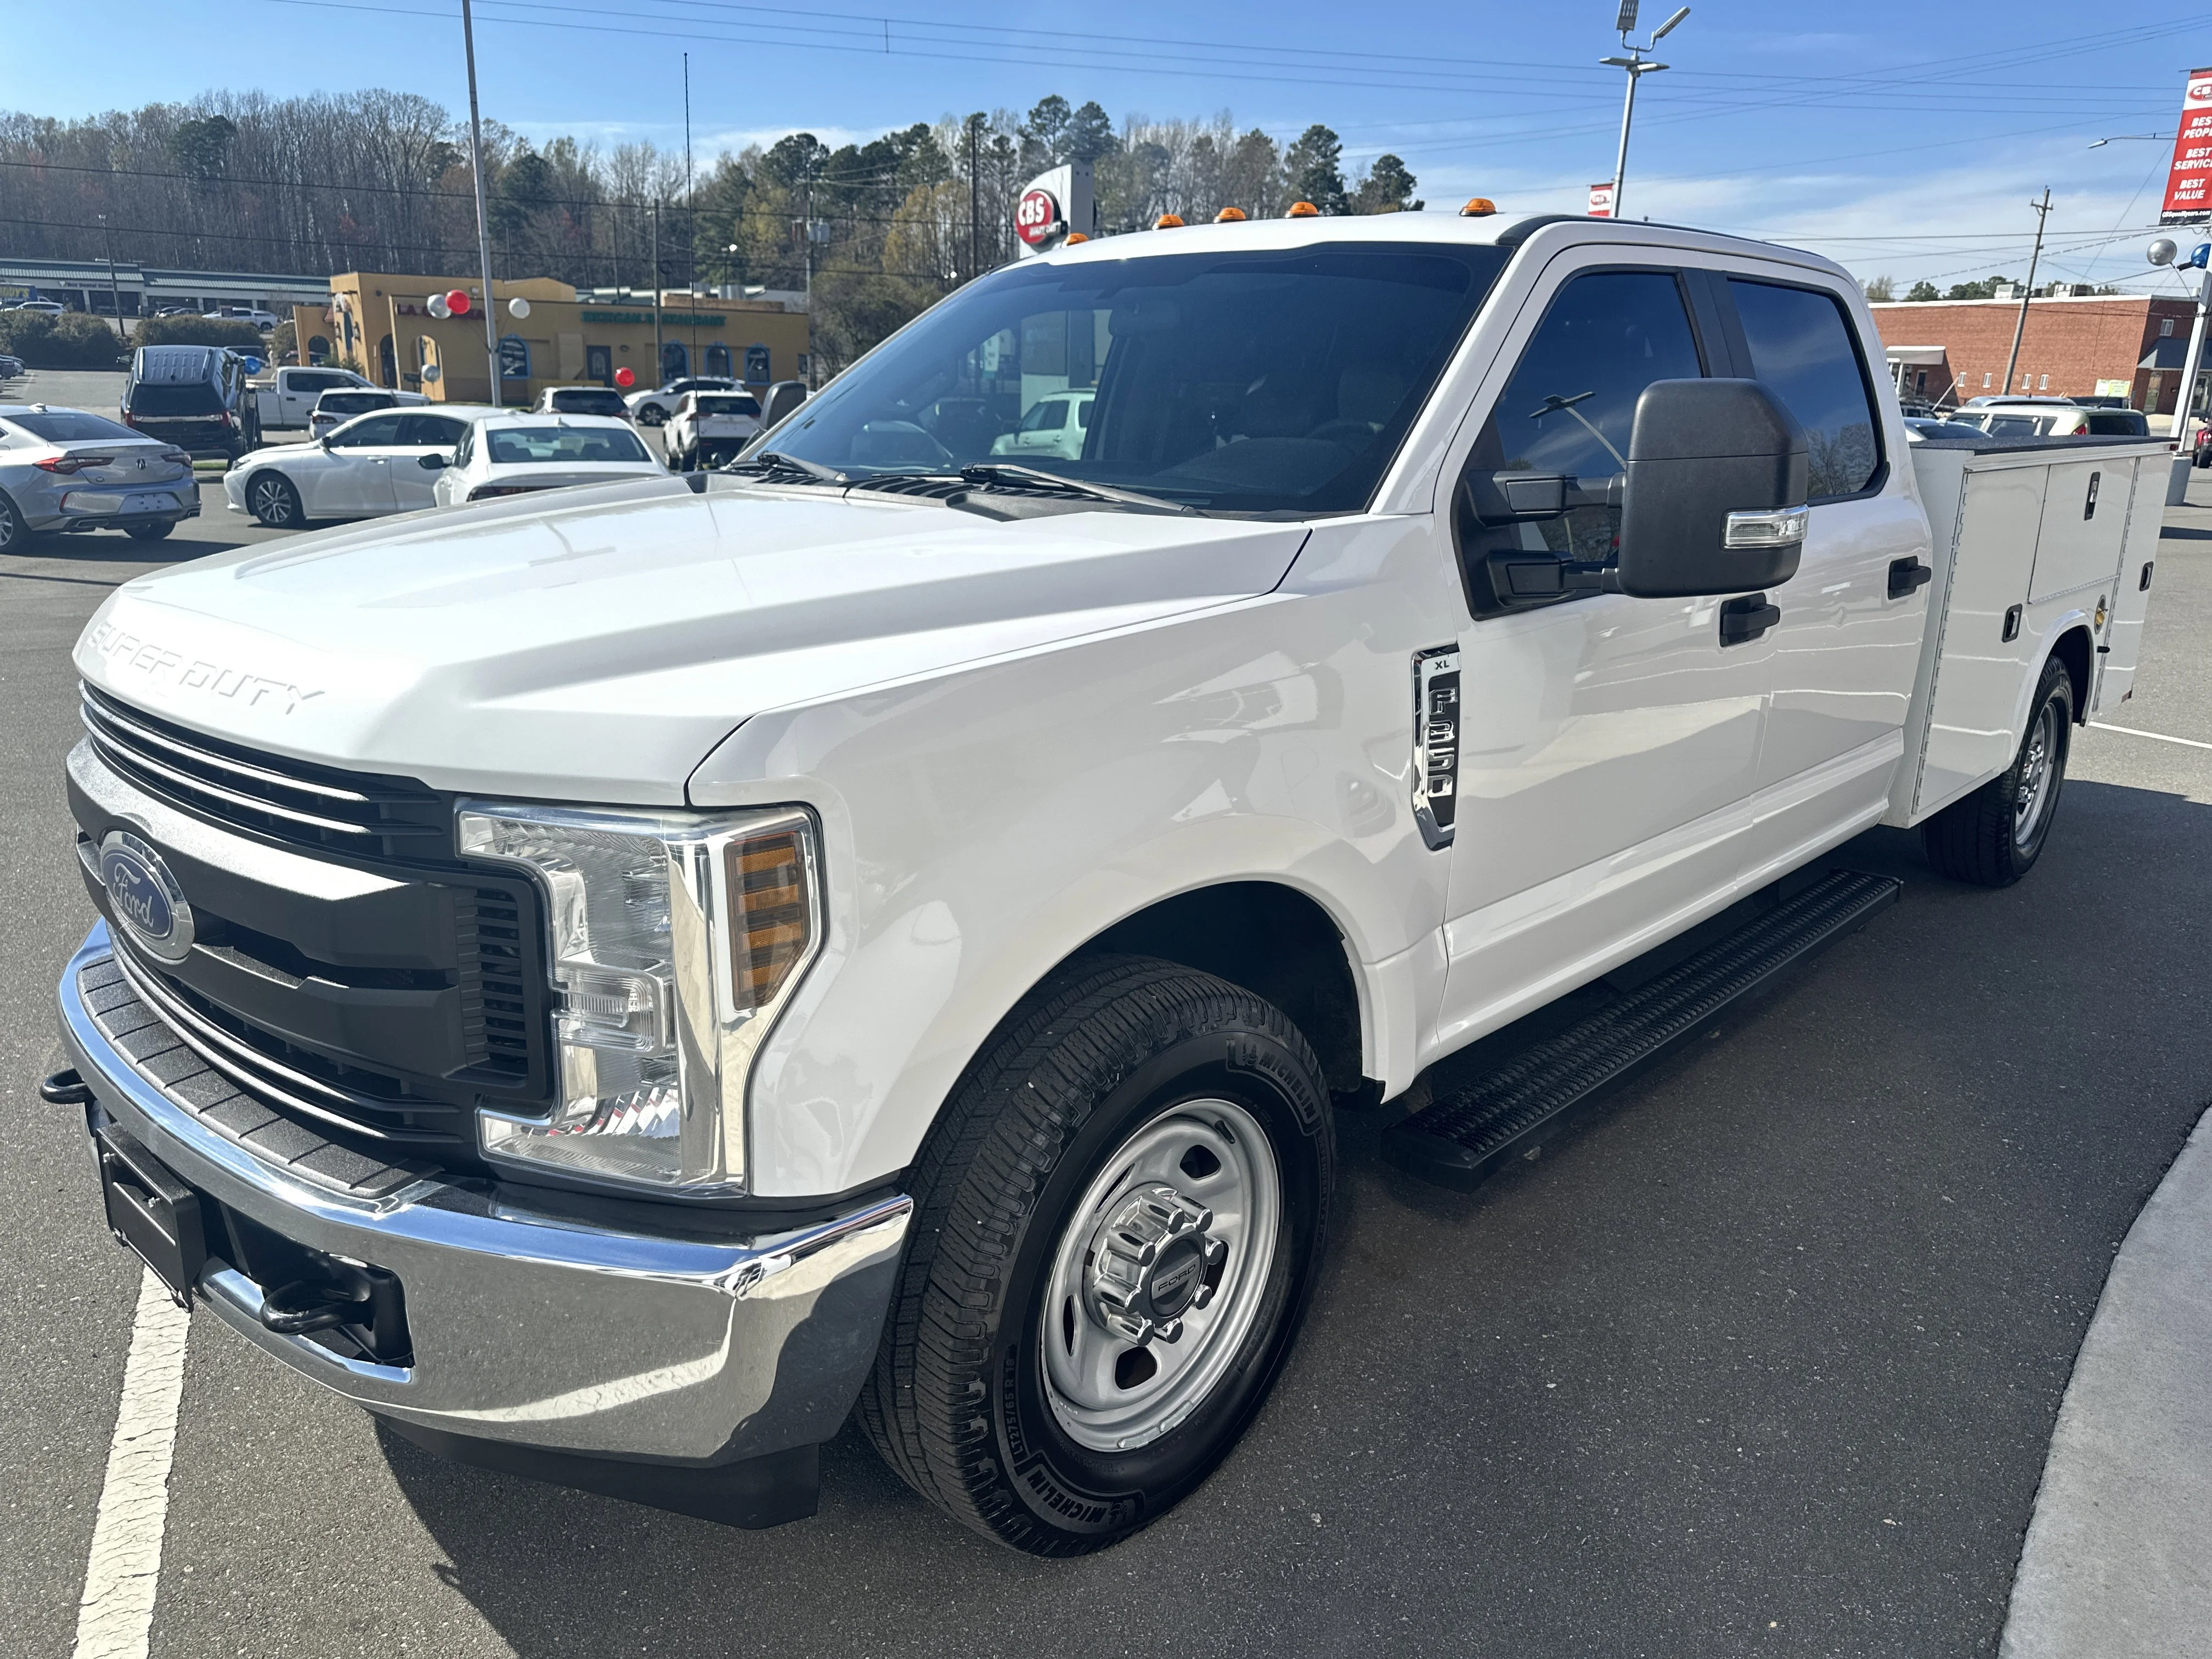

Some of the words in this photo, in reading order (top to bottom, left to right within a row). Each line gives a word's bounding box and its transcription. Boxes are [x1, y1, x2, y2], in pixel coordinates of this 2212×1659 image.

[2193, 85, 2212, 96] CB
[2191, 116, 2212, 127] BES
[2185, 147, 2212, 159] BEST
[2180, 178, 2205, 189] BEST
[2174, 190, 2205, 200] VALUE
[1018, 197, 1045, 226] CBS
[87, 621, 183, 674] SUPER
[179, 660, 325, 715] DUTY
[1435, 660, 1449, 670] XL
[112, 862, 154, 928] Ford
[1259, 1049, 1317, 1119] MICHELIN
[1158, 1263, 1196, 1291] FORD
[1006, 1358, 1015, 1373] 18
[1005, 1379, 1014, 1387] R
[1005, 1393, 1023, 1455] LT275/65
[1026, 1463, 1108, 1523] MICHELIN
